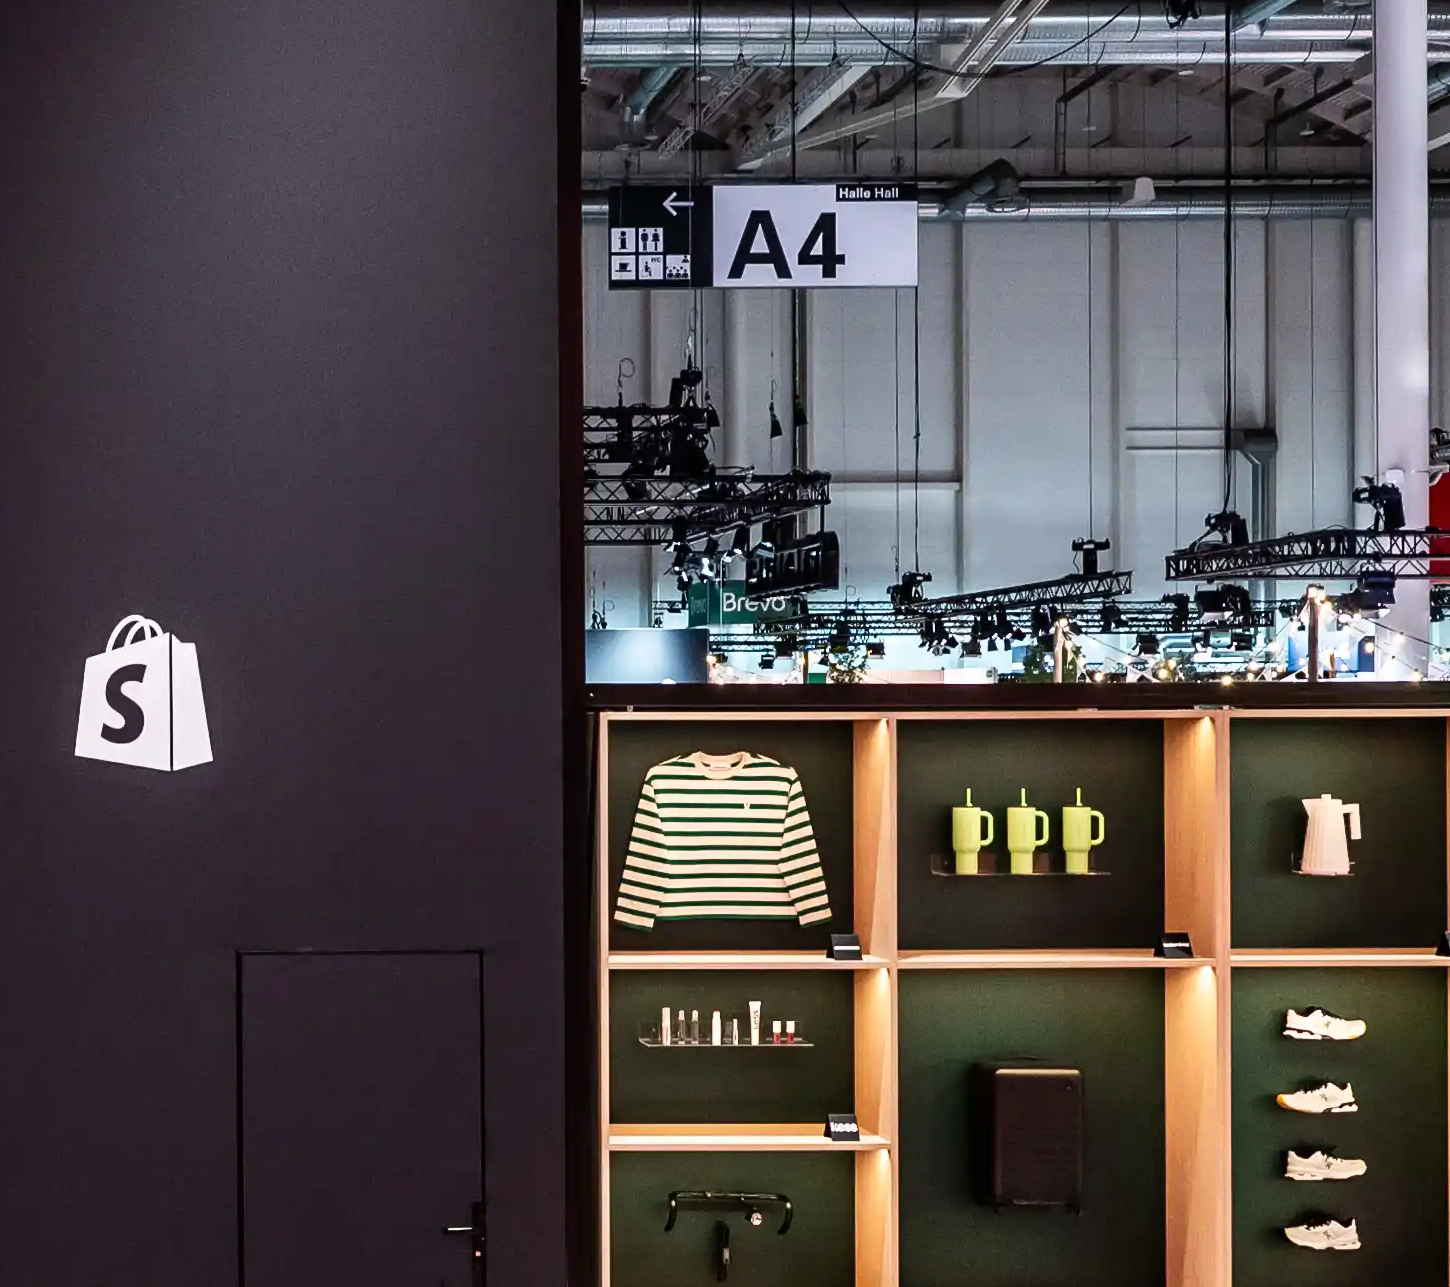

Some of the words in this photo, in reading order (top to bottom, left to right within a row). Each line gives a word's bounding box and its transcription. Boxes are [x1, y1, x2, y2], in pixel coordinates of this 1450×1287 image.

[839, 188, 871, 199] Halle
[727, 210, 845, 279] A4
[723, 592, 786, 613] Brevo
